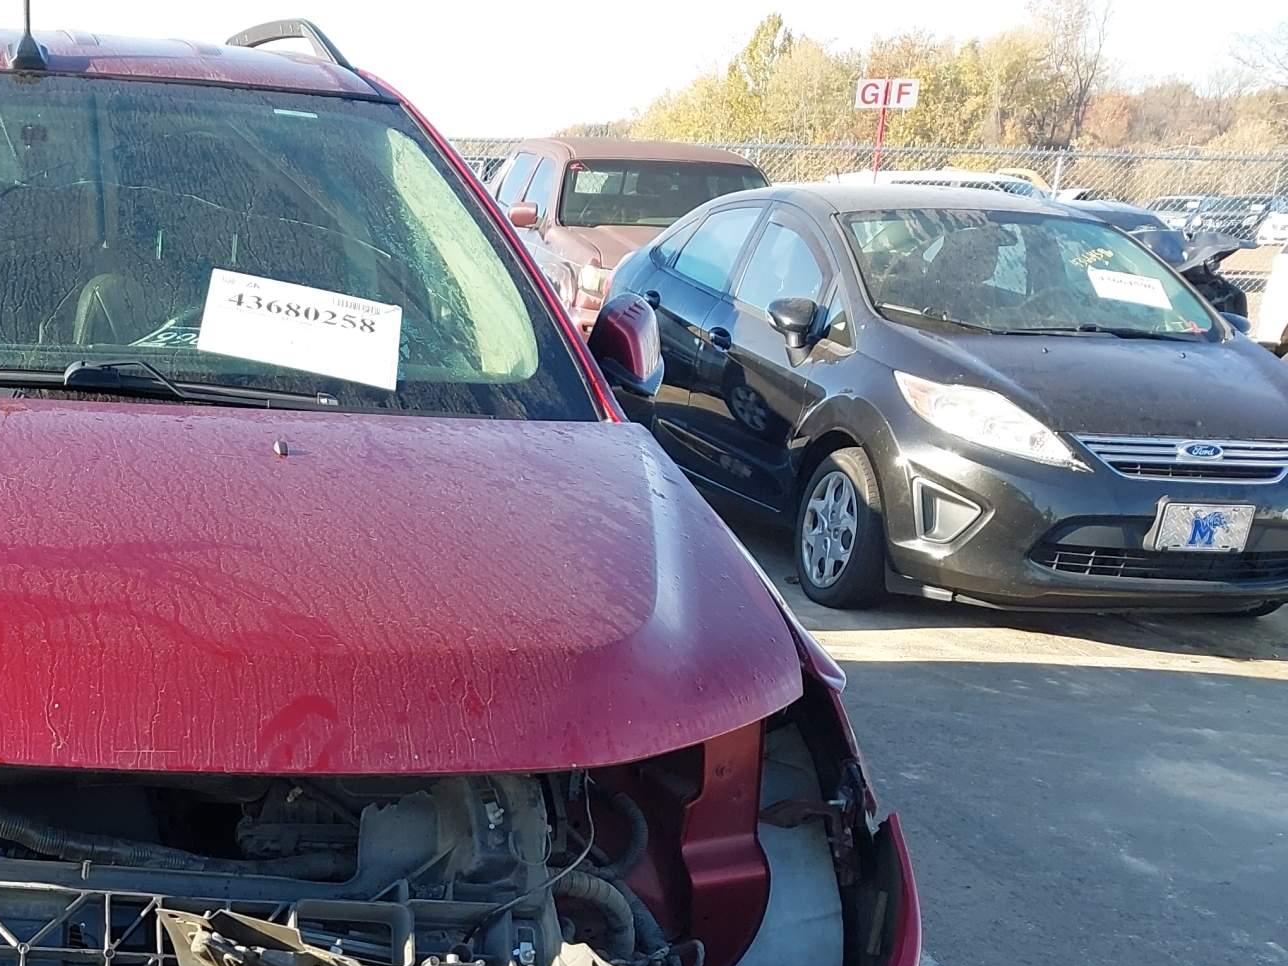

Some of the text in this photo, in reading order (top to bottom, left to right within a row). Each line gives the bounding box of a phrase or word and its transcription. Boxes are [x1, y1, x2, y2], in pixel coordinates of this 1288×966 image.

[860, 82, 913, 105] G F
[228, 292, 376, 333] 43680258
